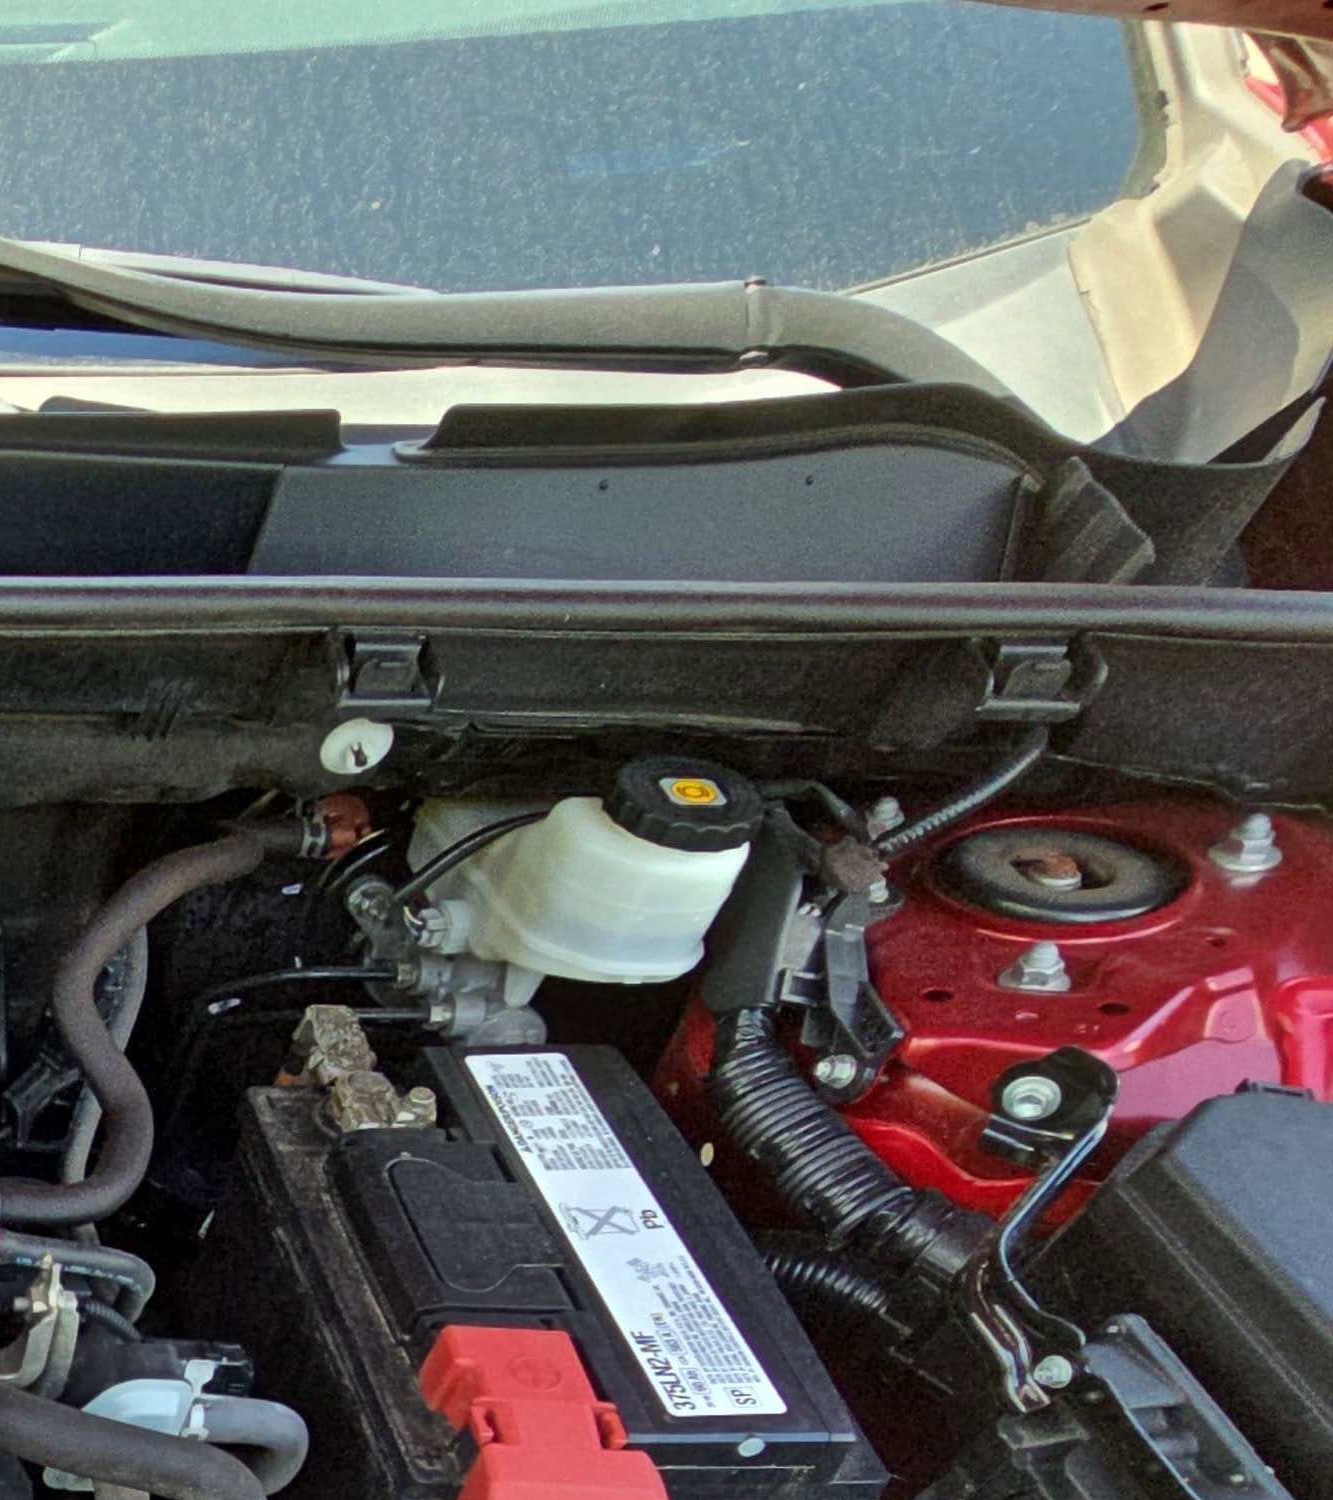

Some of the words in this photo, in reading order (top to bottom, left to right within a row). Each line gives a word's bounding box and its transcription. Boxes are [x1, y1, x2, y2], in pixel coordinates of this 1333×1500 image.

[639, 1209, 665, 1229] Pb
[630, 1330, 696, 1411] 375LN2-MF
[731, 1389, 757, 1406] SP
